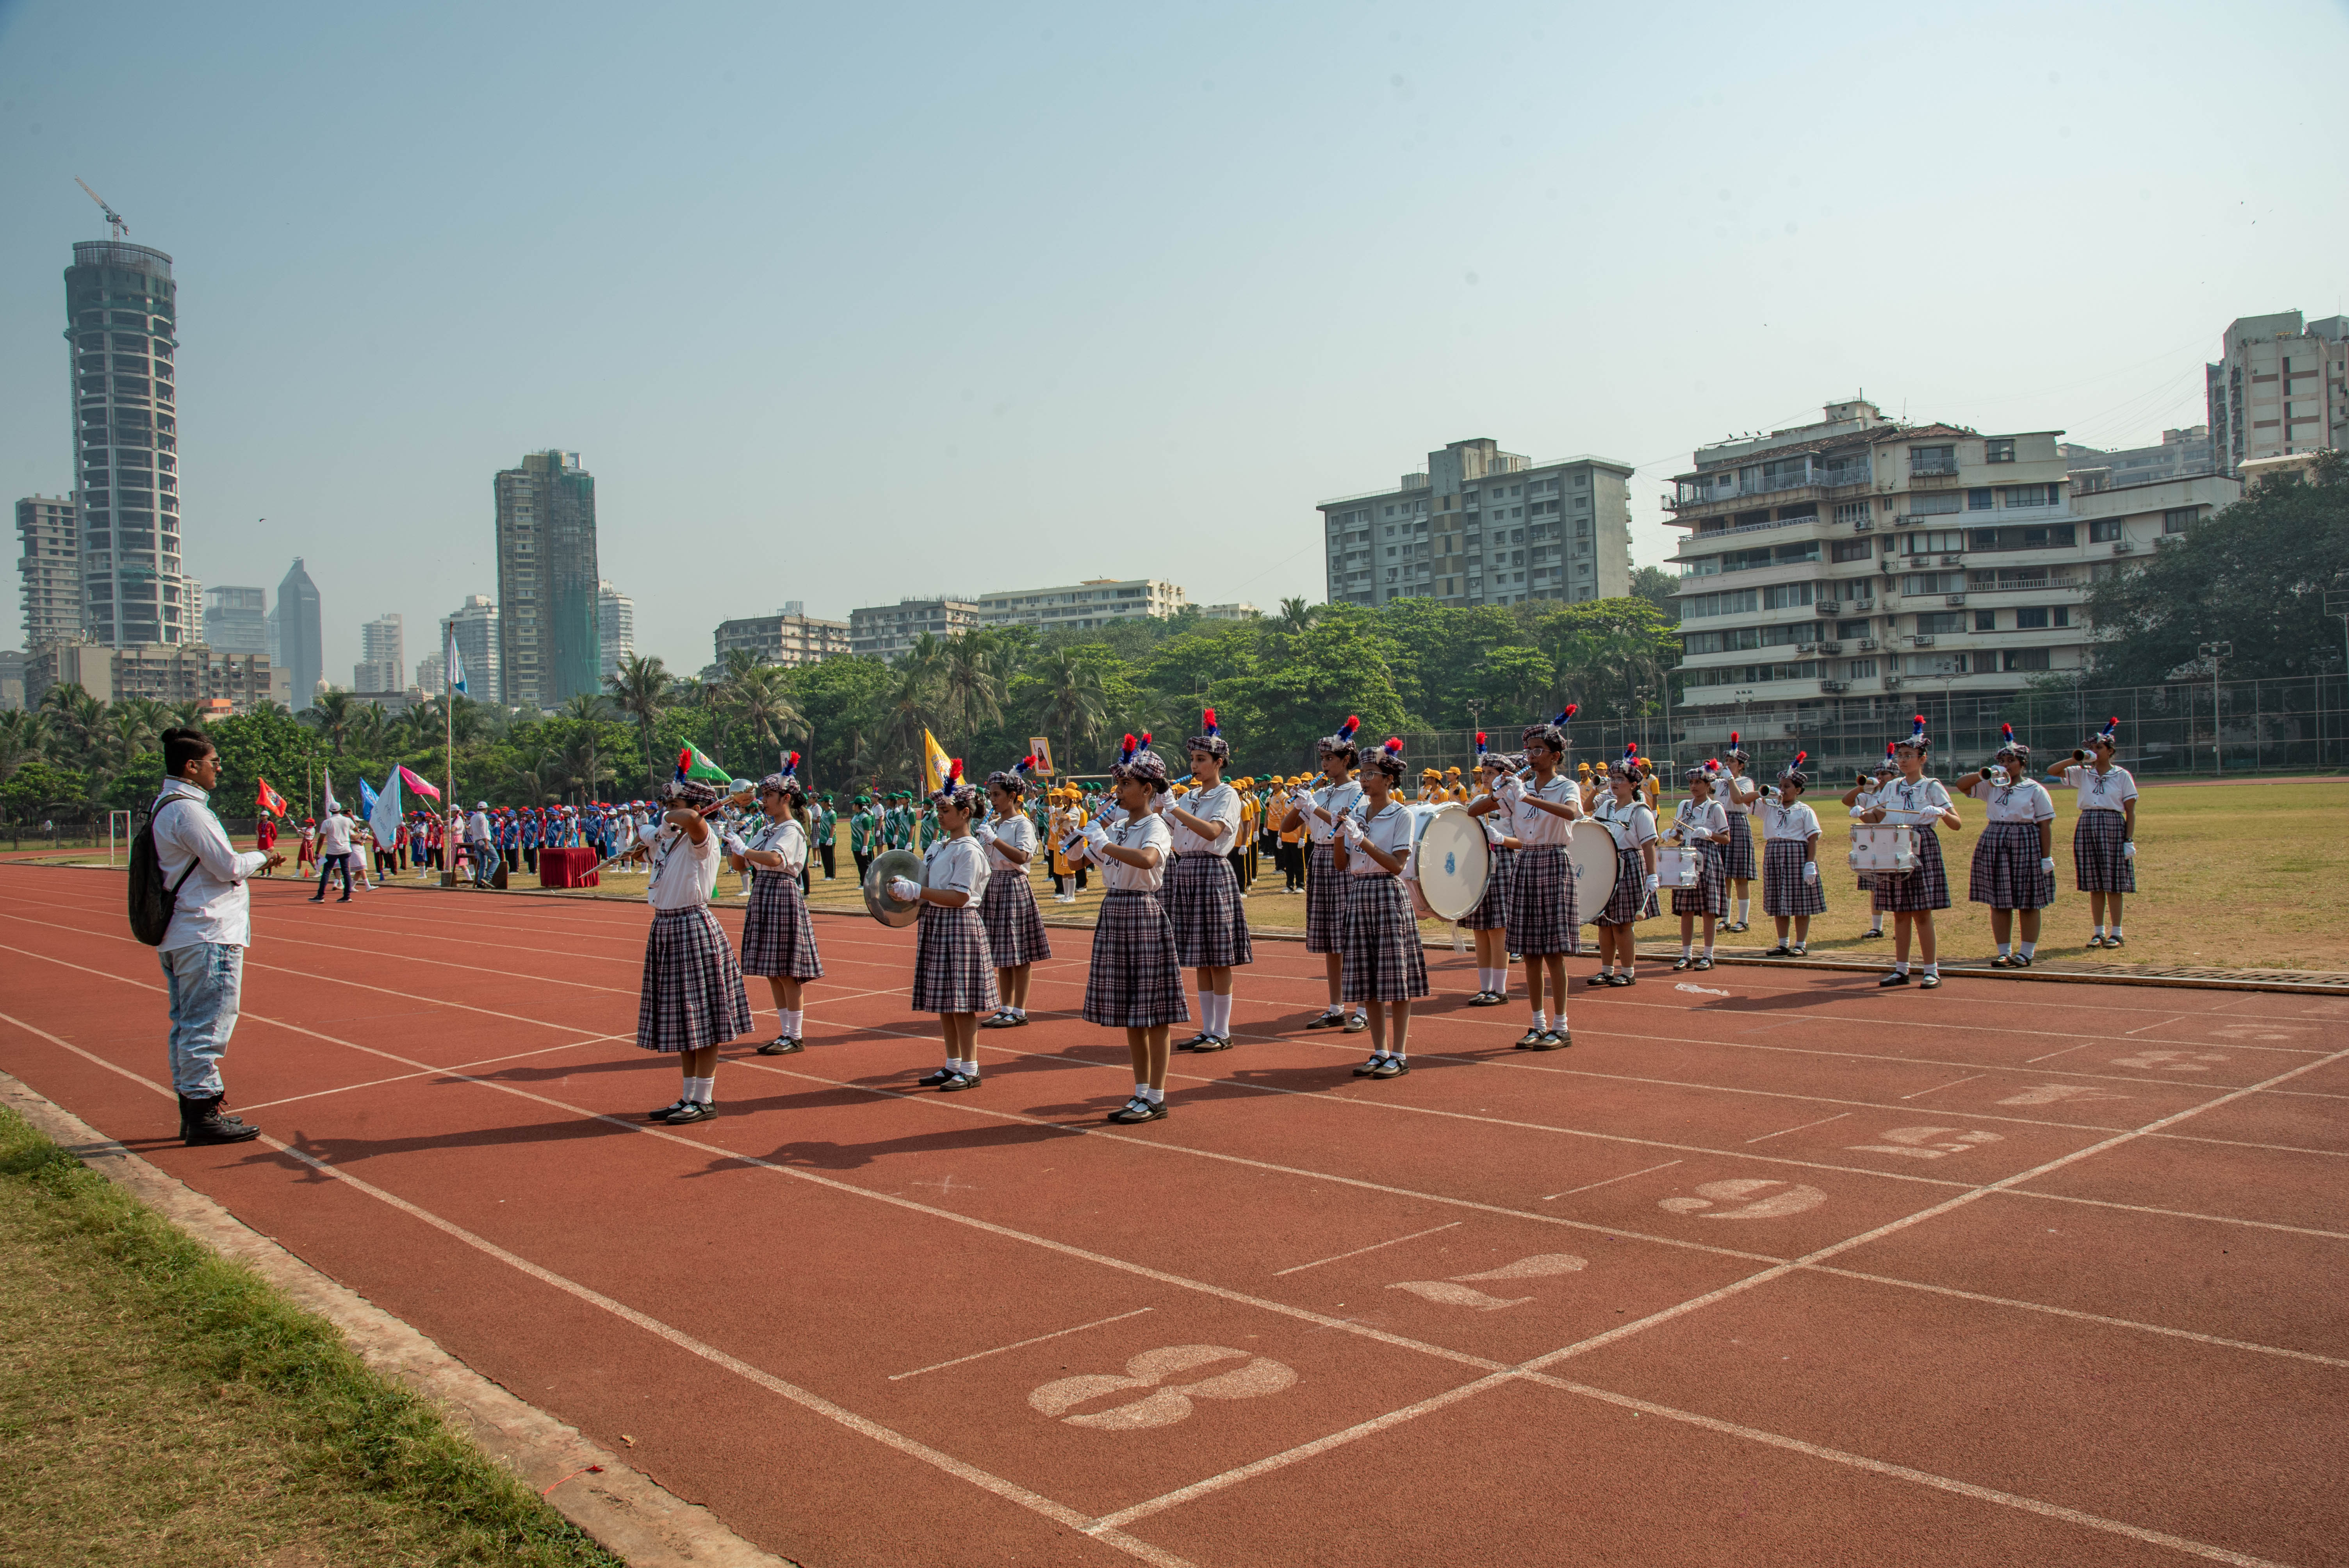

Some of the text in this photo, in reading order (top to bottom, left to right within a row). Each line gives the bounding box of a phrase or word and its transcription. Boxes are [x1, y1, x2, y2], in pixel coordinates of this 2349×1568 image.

[2109, 1050, 2231, 1071] 3
[1996, 1083, 2133, 1106] 4
[1843, 1126, 2005, 1160] 5
[1658, 1178, 1828, 1219] 6
[1384, 1253, 1589, 1311] 7
[1028, 1344, 1299, 1431] 8
